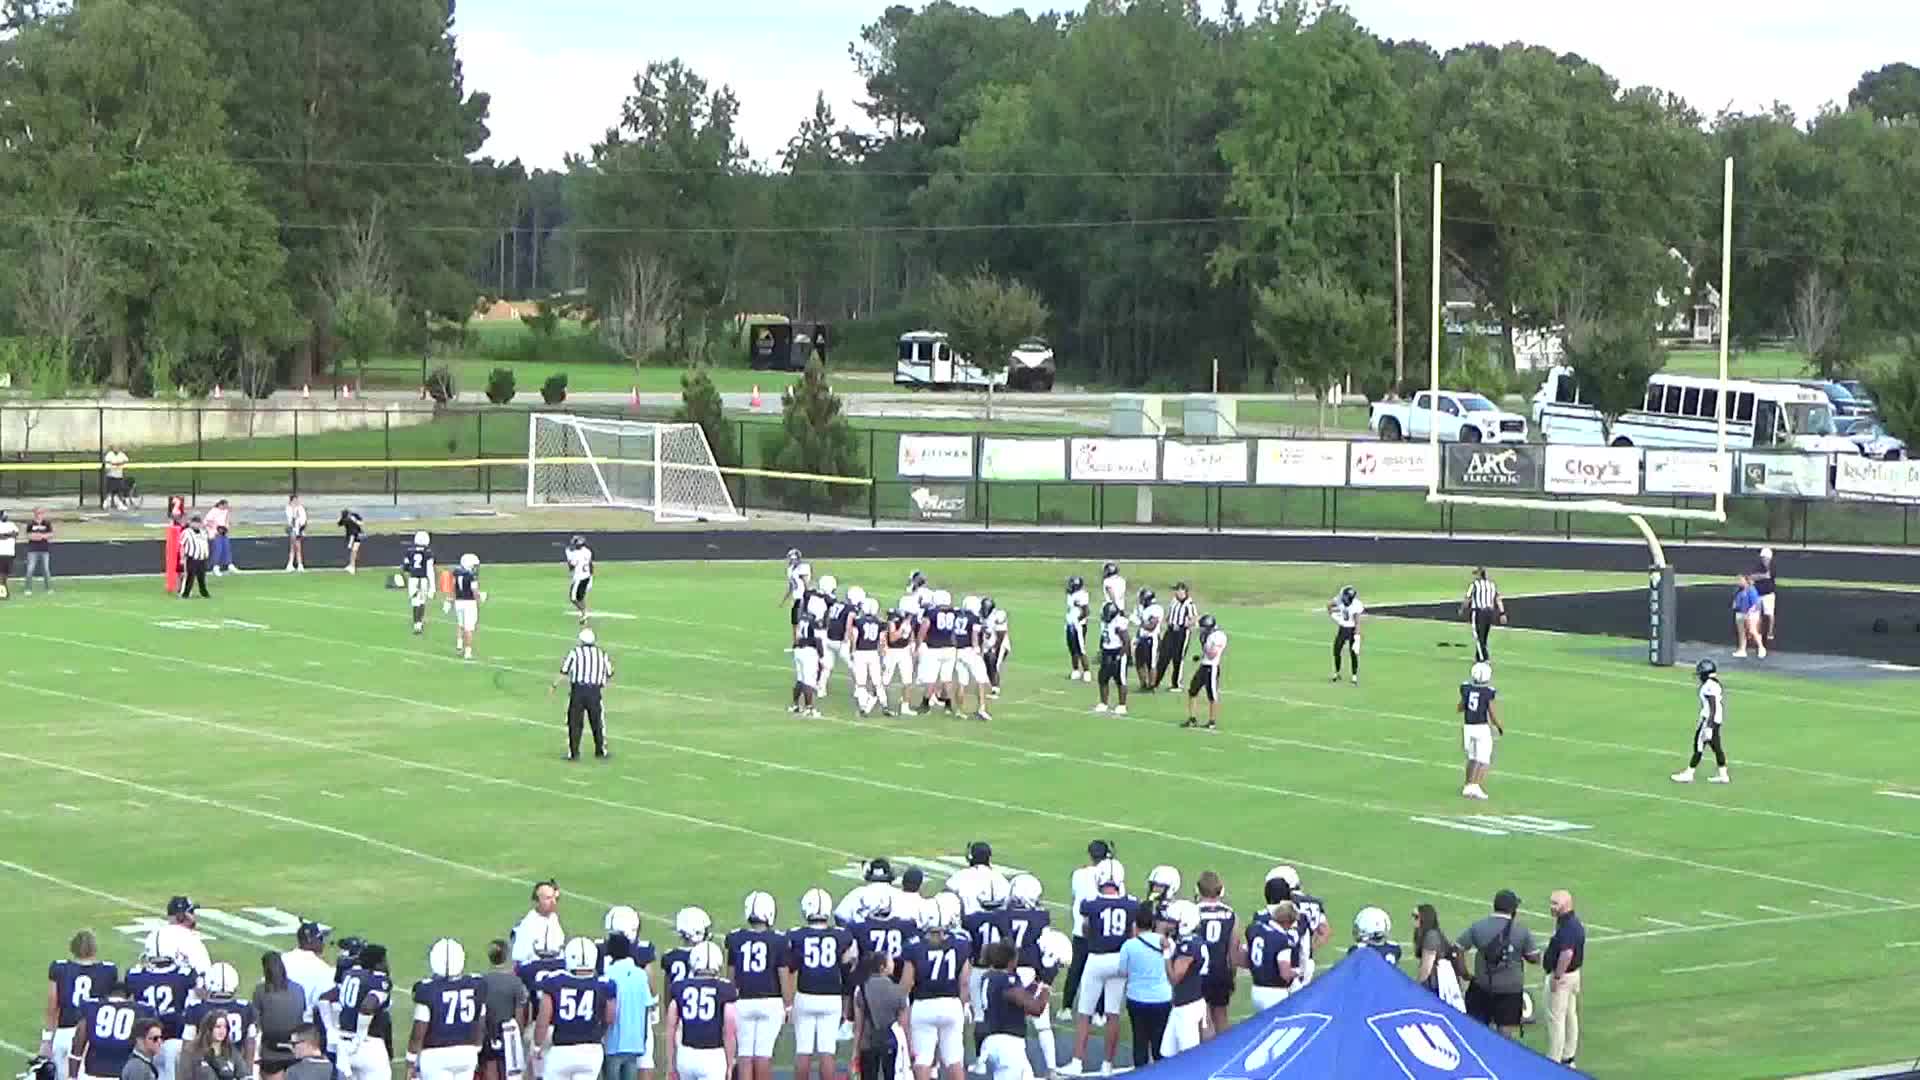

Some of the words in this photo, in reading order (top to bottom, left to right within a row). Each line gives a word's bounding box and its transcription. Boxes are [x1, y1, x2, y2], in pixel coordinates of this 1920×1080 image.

[1467, 449, 1518, 475] ARC
[1565, 458, 1622, 479] Clay's
[413, 554, 423, 570] 2
[1468, 692, 1479, 711] 5
[1011, 919, 1029, 948] 7
[1100, 907, 1127, 937] 19
[1205, 919, 1222, 943] 0
[740, 940, 768, 973] 13
[803, 936, 837, 969] 58
[869, 929, 902, 960] 78
[1251, 936, 1265, 966] 6
[927, 949, 956, 981] 71
[143, 984, 175, 1016] 12
[441, 988, 476, 1024] 75
[558, 987, 594, 1021] 54
[682, 986, 717, 1021] 35
[95, 1004, 136, 1041] 90
